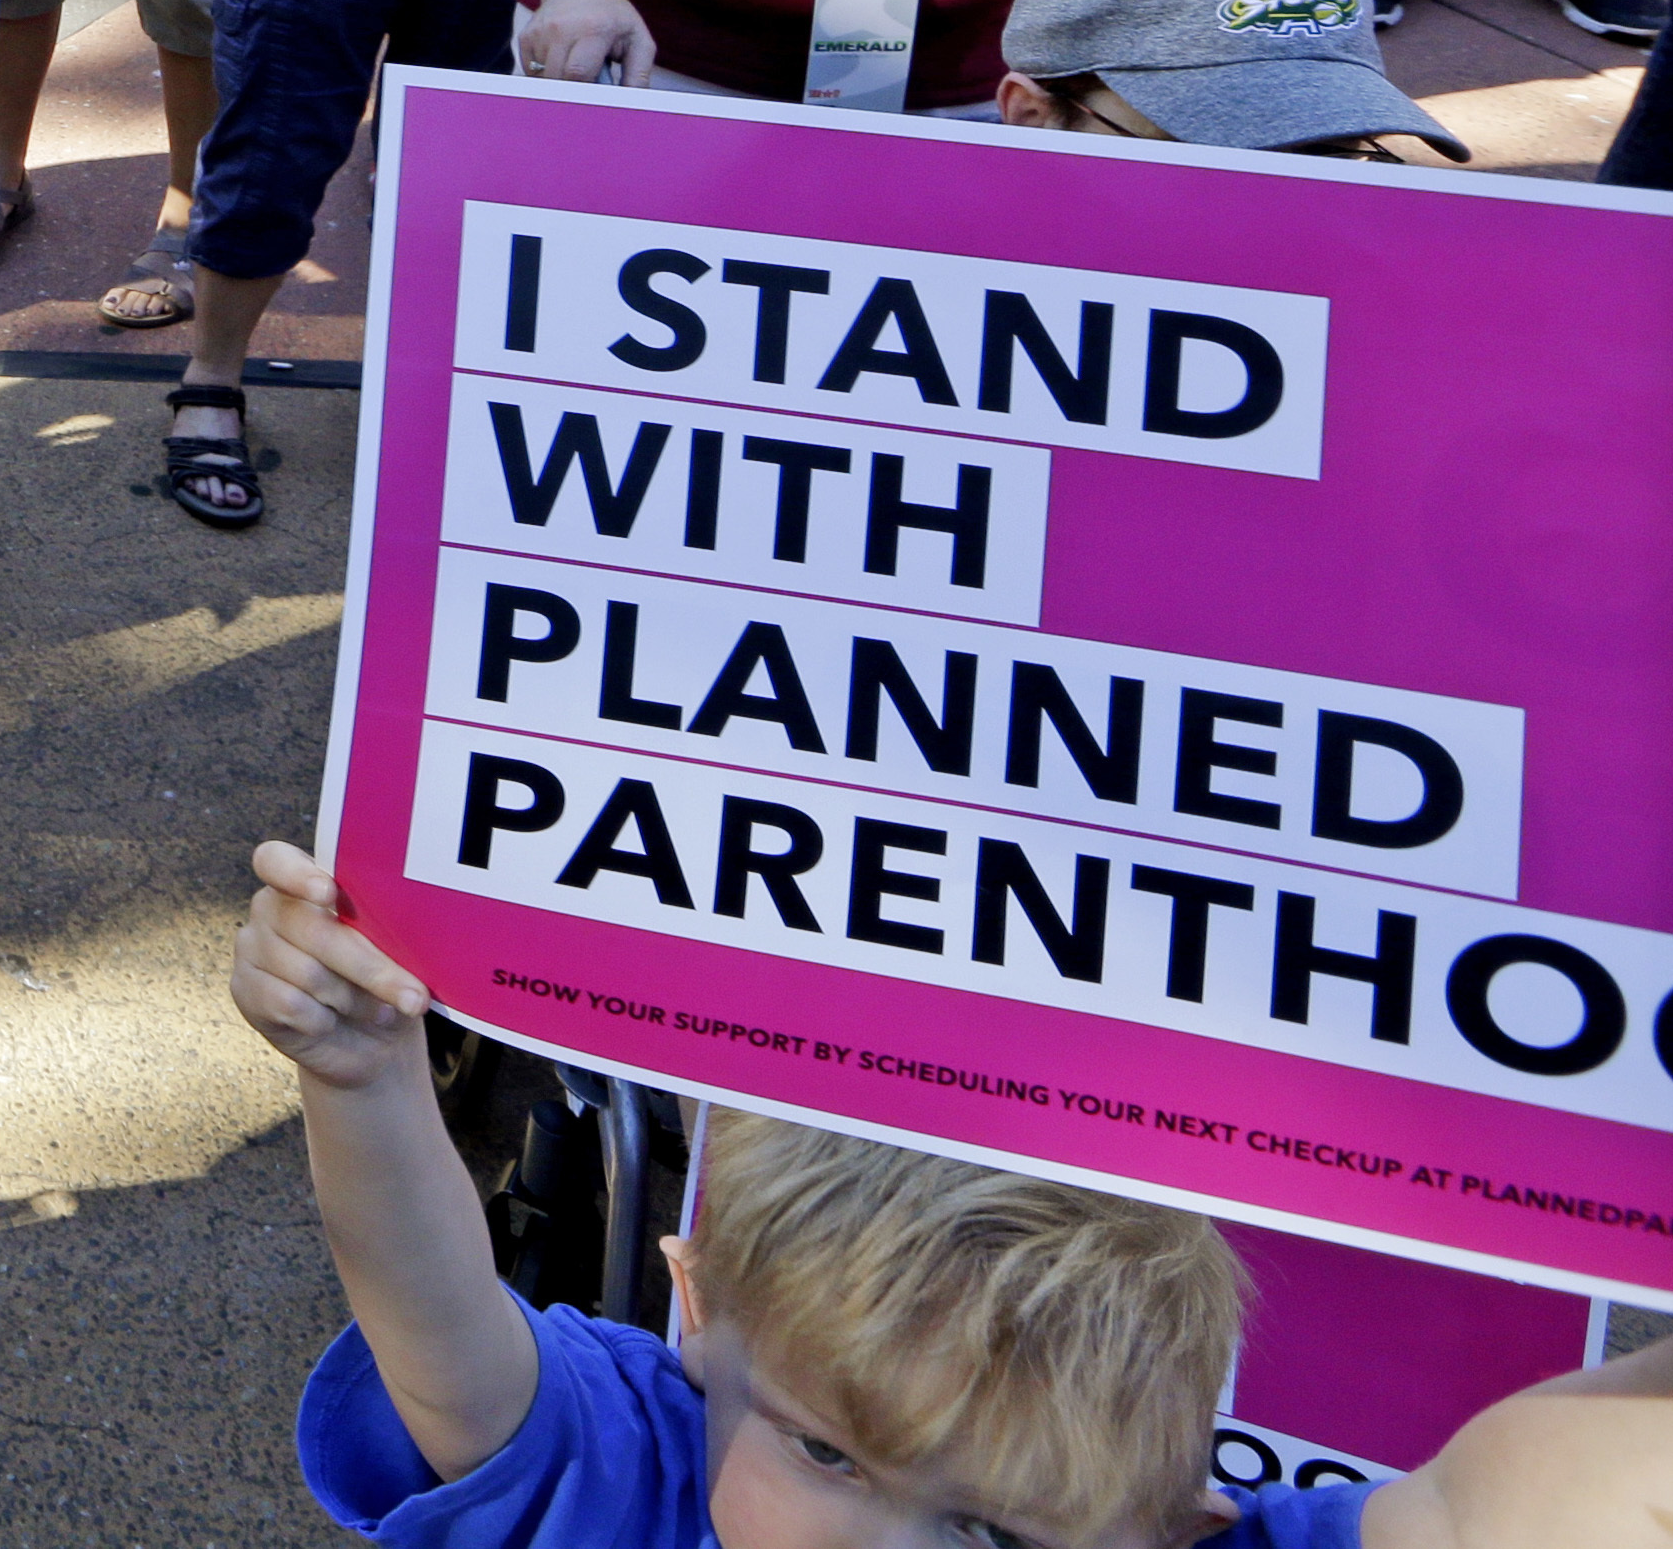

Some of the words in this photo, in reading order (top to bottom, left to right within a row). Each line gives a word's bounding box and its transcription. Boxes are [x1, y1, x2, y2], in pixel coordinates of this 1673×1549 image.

[814, 41, 907, 52] EMERALD
[506, 234, 542, 353] I
[608, 247, 1284, 440] STAND
[488, 401, 994, 589] WITH
[476, 583, 1465, 850] PLANNED
[457, 752, 1673, 1081] PARENTHO
[492, 967, 582, 1008] SHOW
[588, 988, 667, 1028] YOUR
[673, 1007, 810, 1059] SUPPORT
[813, 1037, 852, 1066] BY
[858, 1048, 1051, 1108] SCHEDULING
[1058, 1087, 1145, 1125] YOUR
[1154, 1104, 1237, 1145] NEXT
[1246, 1127, 1403, 1182] CHECKUP
[1410, 1162, 1453, 1189] AT
